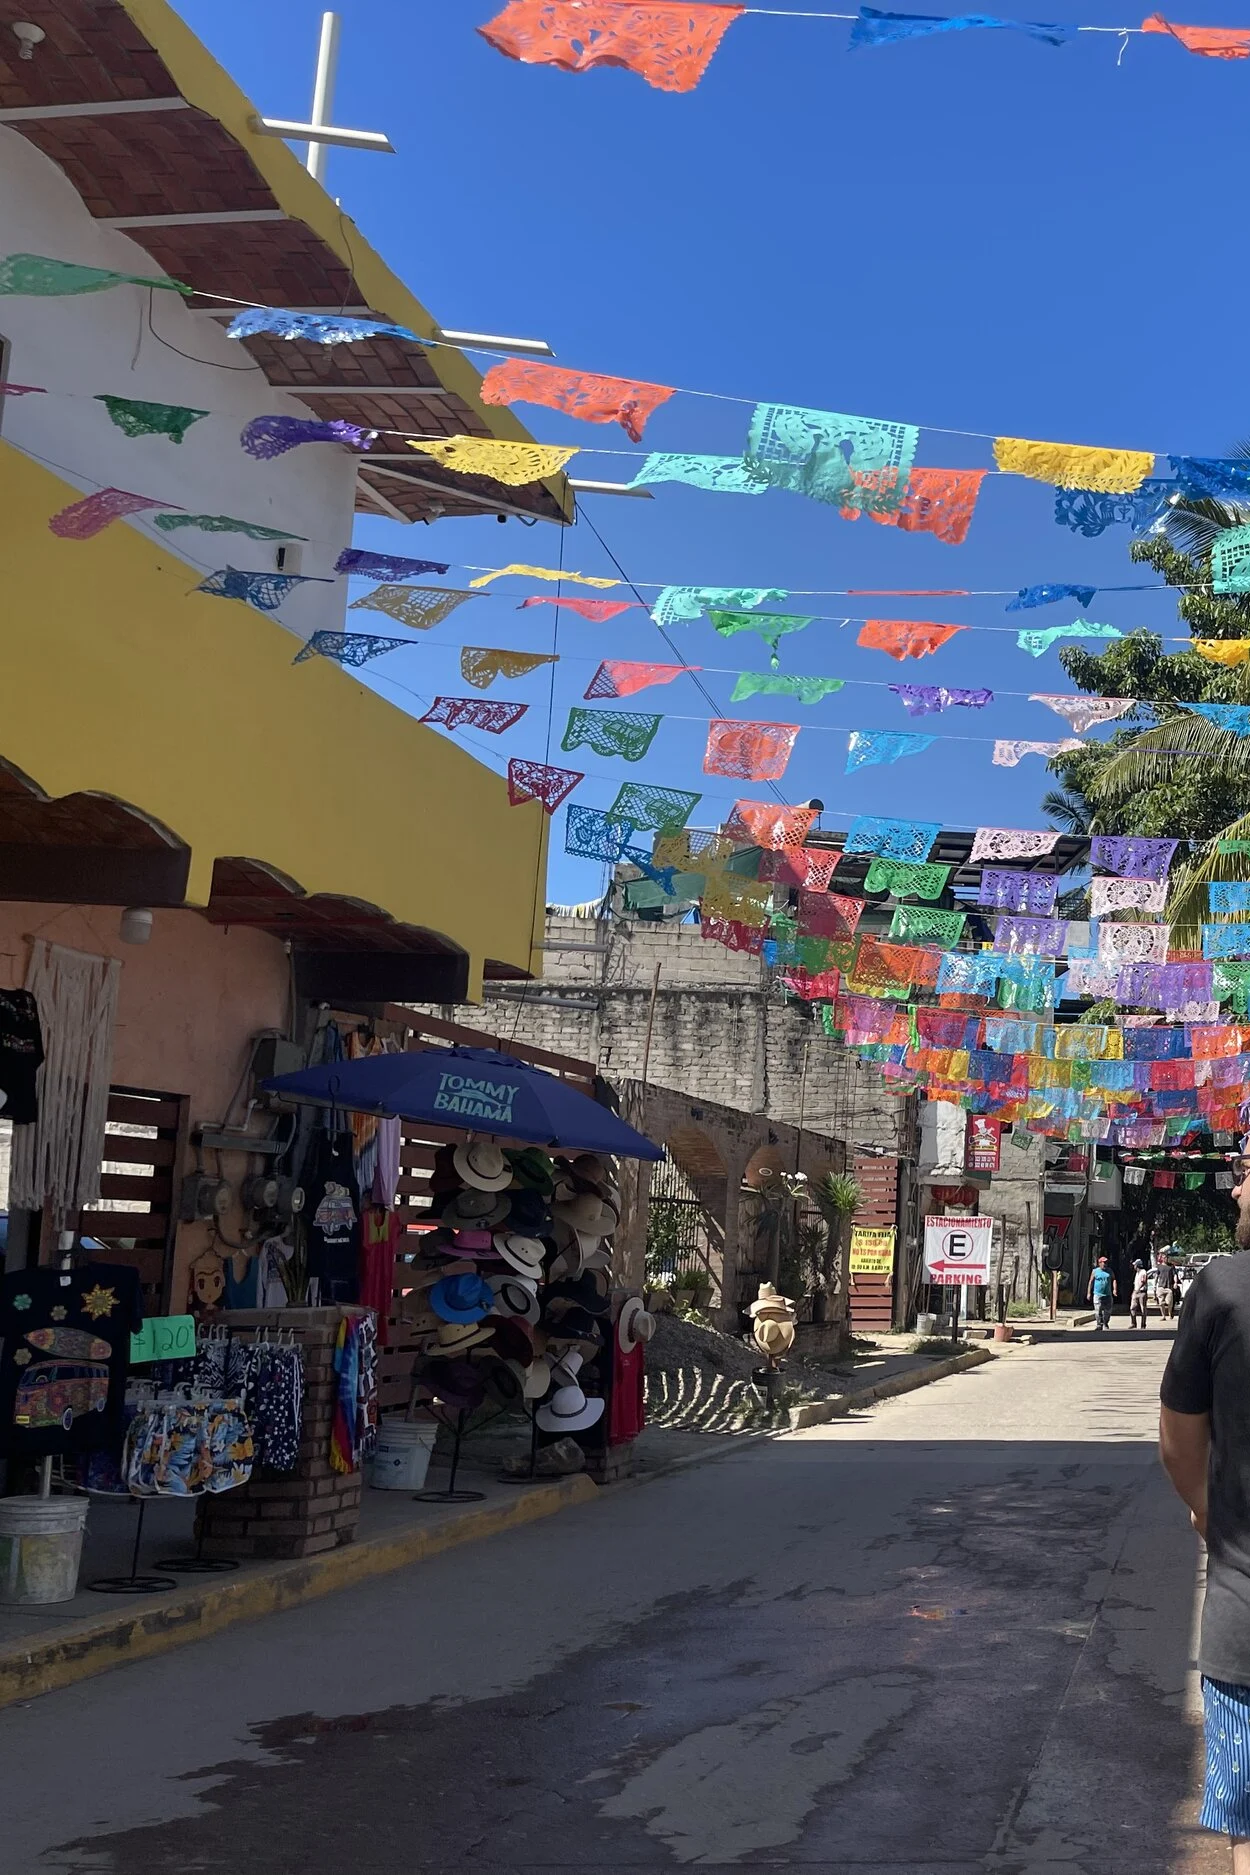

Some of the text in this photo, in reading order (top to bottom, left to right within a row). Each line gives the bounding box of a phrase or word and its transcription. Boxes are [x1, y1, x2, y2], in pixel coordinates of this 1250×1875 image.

[439, 1072, 520, 1104] TOMMY
[433, 1092, 513, 1123] BAHAMA
[926, 1216, 992, 1228] ESTACIONAMIENTO
[949, 1234, 966, 1256] E
[929, 1273, 983, 1285] PARKING
